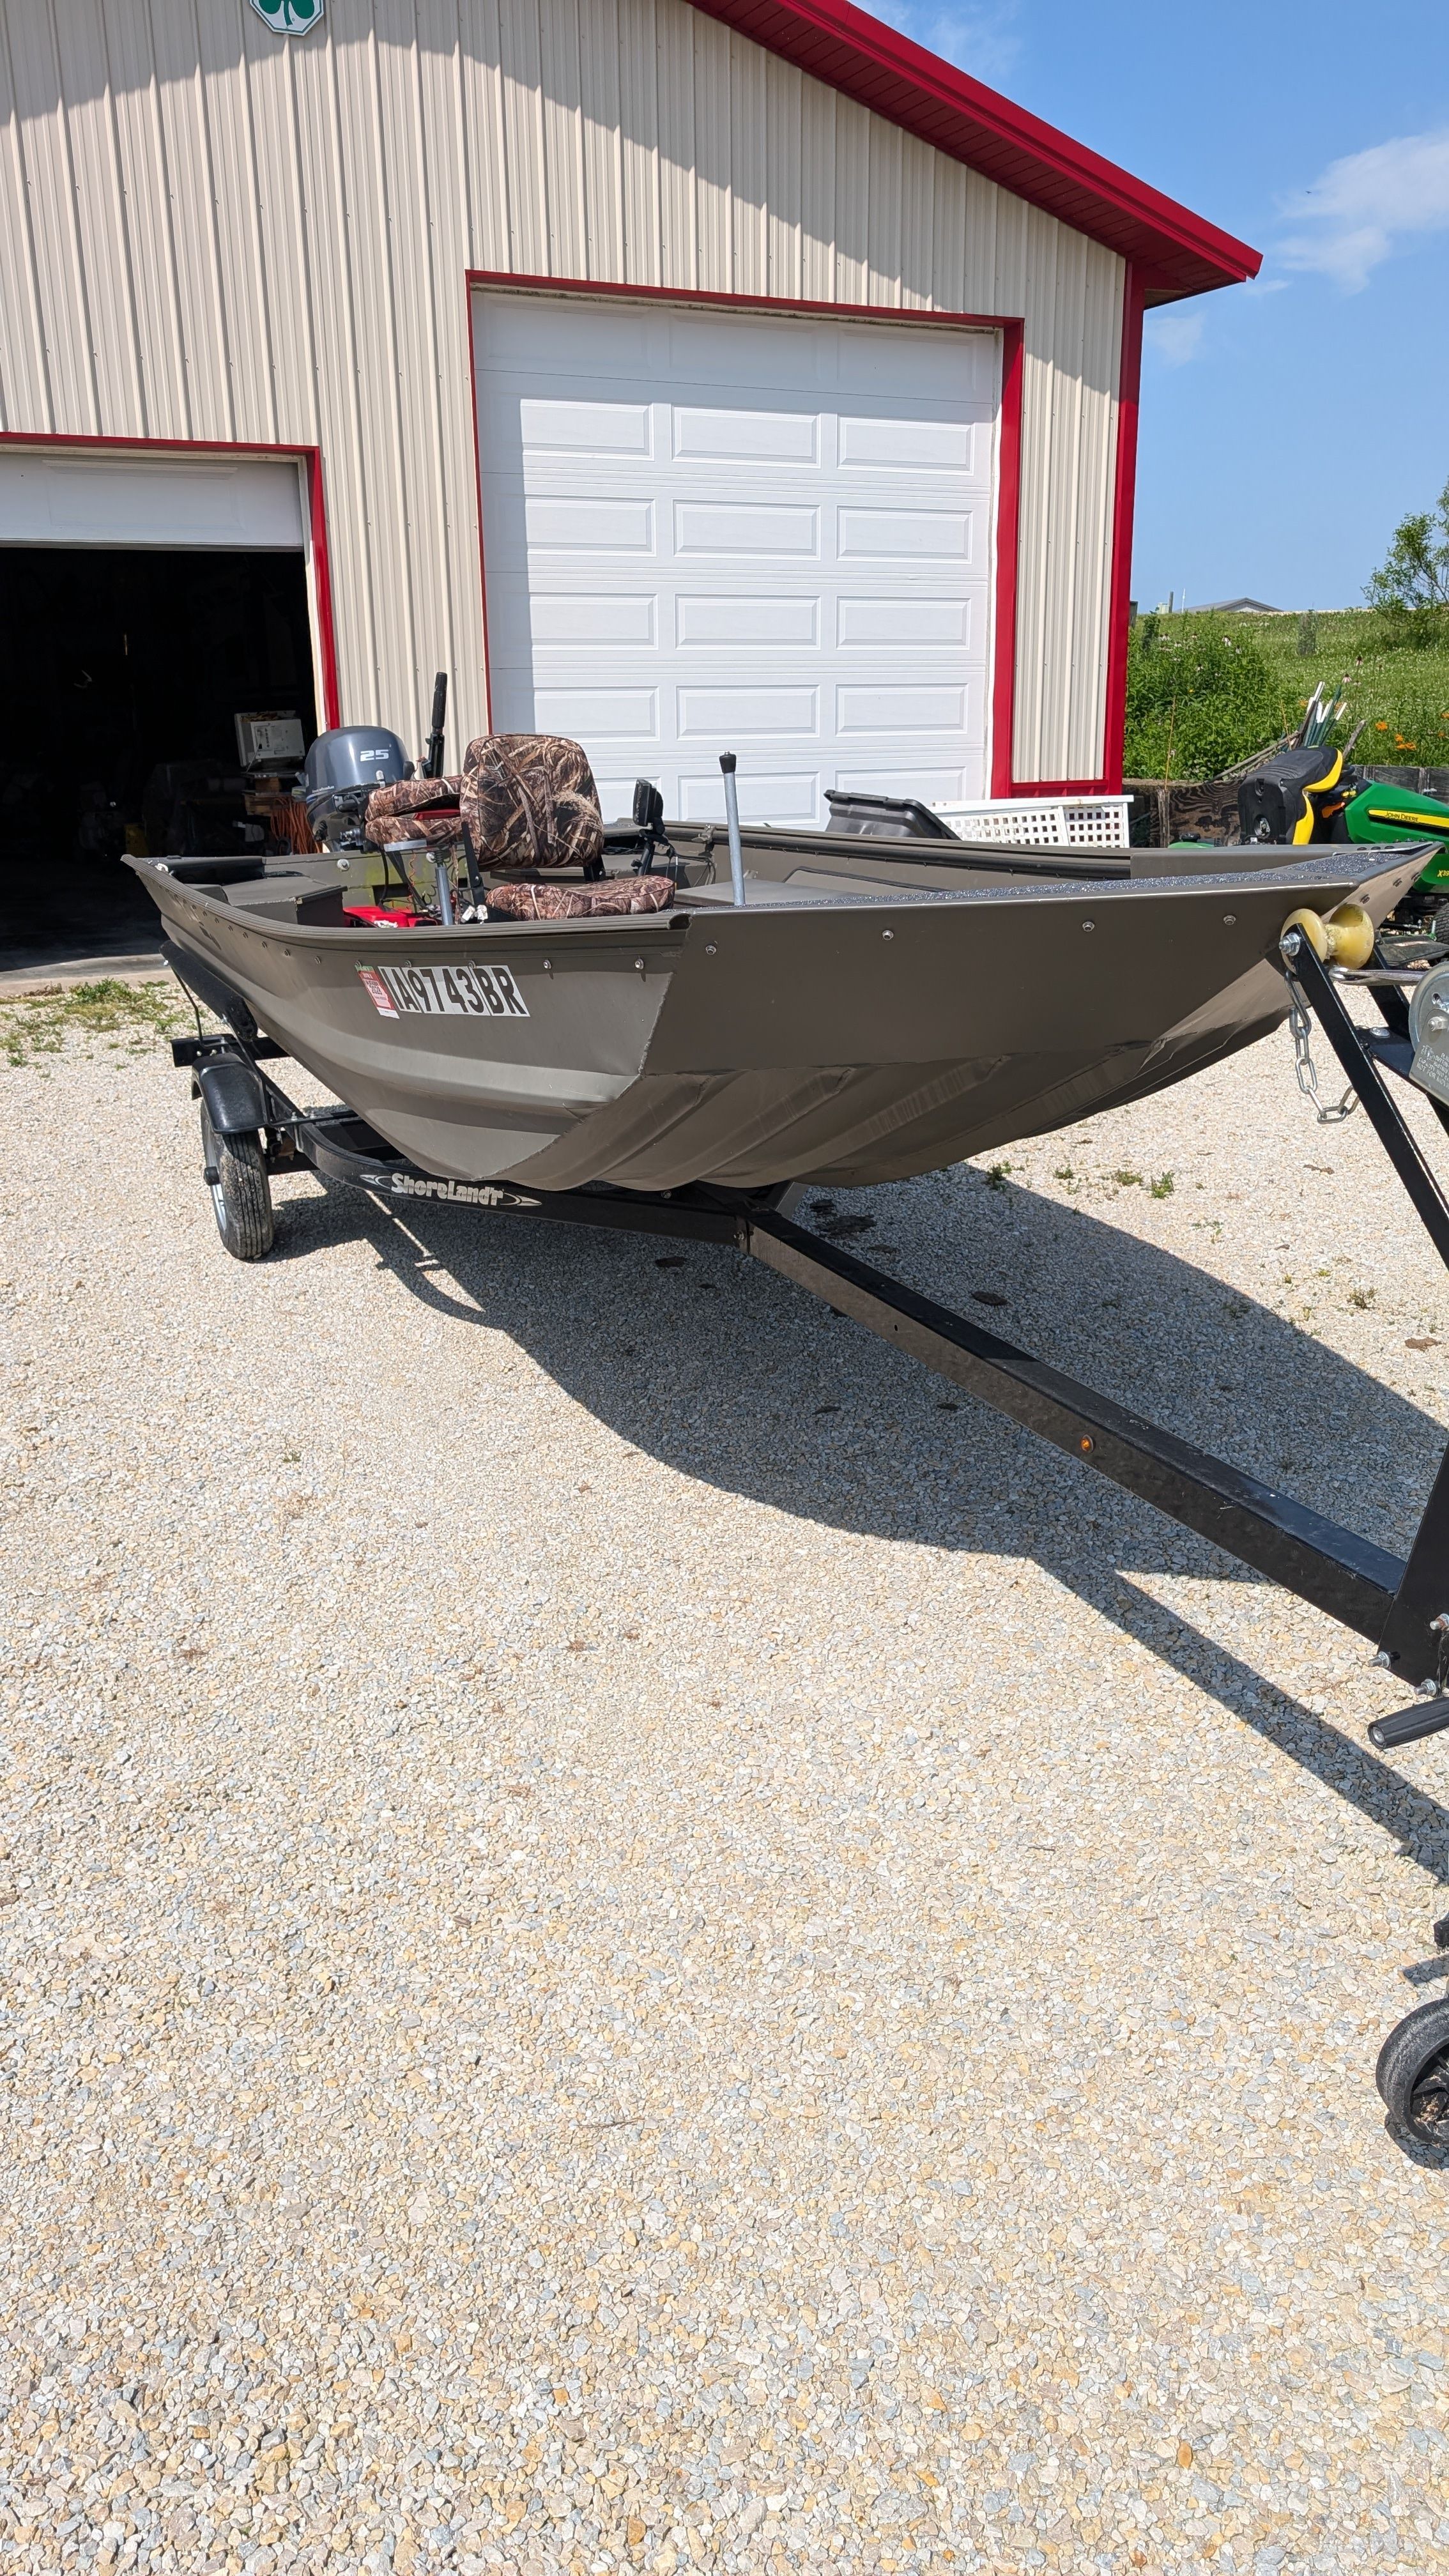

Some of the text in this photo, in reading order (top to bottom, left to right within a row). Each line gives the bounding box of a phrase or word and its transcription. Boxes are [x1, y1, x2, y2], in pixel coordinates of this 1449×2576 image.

[360, 749, 389, 762] 25
[1384, 811, 1418, 822] JOHN DEERE
